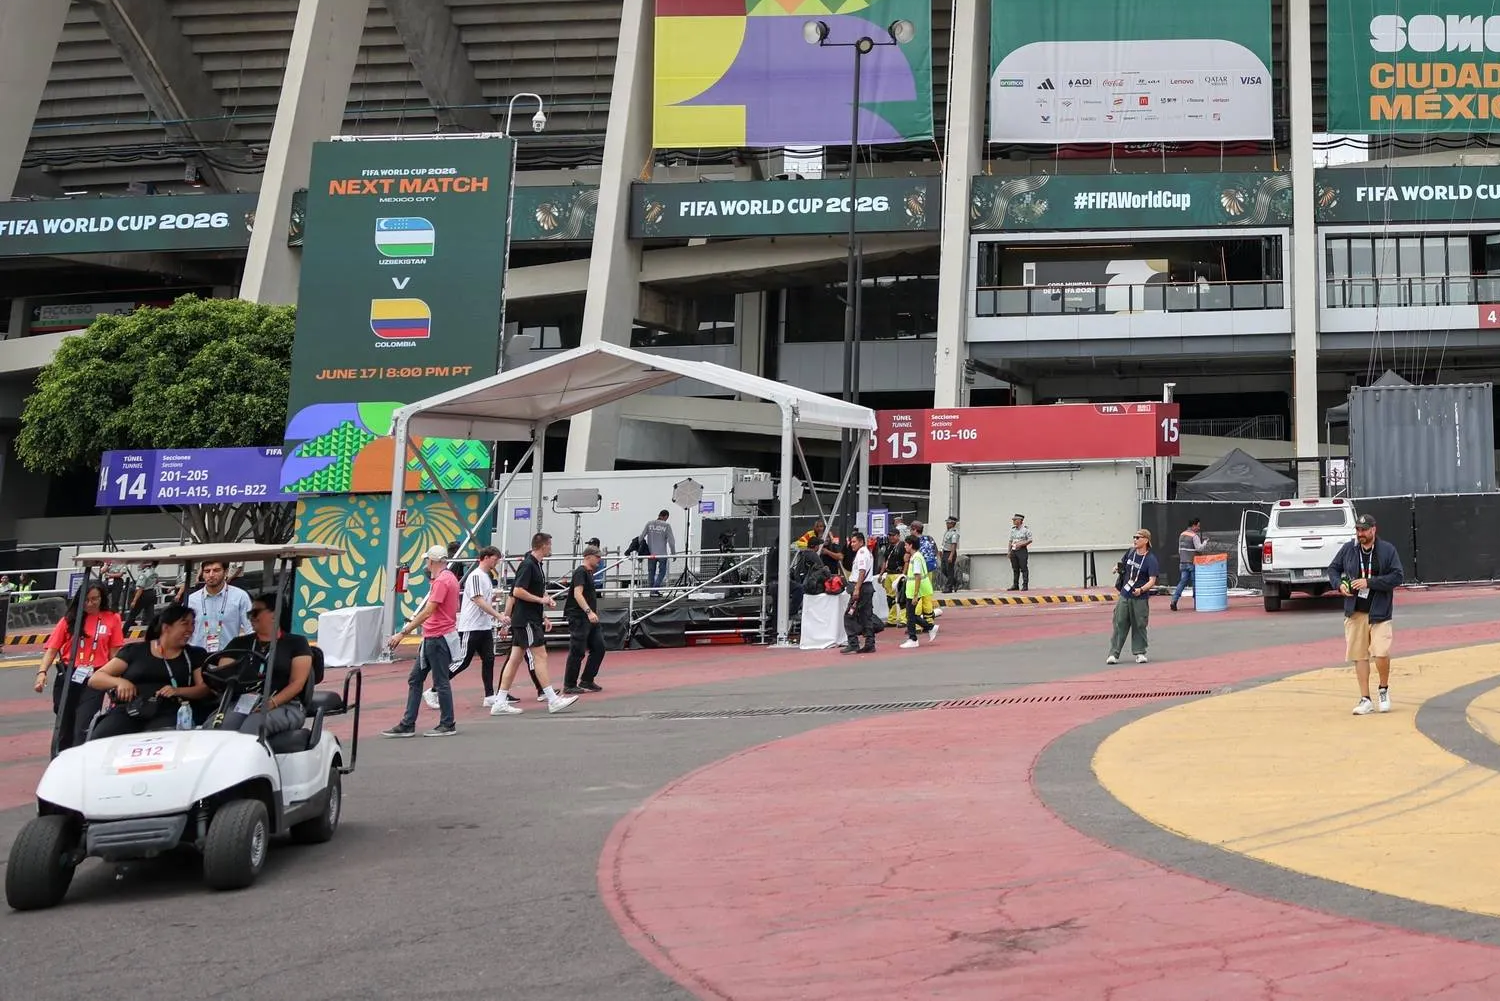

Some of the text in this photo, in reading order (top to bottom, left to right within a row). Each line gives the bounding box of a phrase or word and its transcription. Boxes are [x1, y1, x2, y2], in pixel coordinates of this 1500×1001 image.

[1240, 76, 1262, 85] VISA
[380, 168, 410, 176] WORLD
[328, 176, 489, 195] NEXT MATCH
[1356, 186, 1398, 201] FIFA
[1402, 184, 1473, 201] WORLD
[679, 196, 889, 217] FIFA WORLD CUP 2026
[1073, 190, 1191, 211] #FIFAWorldCup
[0, 212, 229, 236] FIFA WORLD CUP 2026
[391, 277, 411, 290] V
[1487, 310, 1497, 323] 4
[315, 365, 472, 380] JUNE 17 8:00 PM PT
[1161, 418, 1179, 443] 15
[265, 448, 283, 456] FIFA
[886, 432, 918, 459] 15
[115, 472, 147, 501] 14
[131, 745, 164, 758] B12
